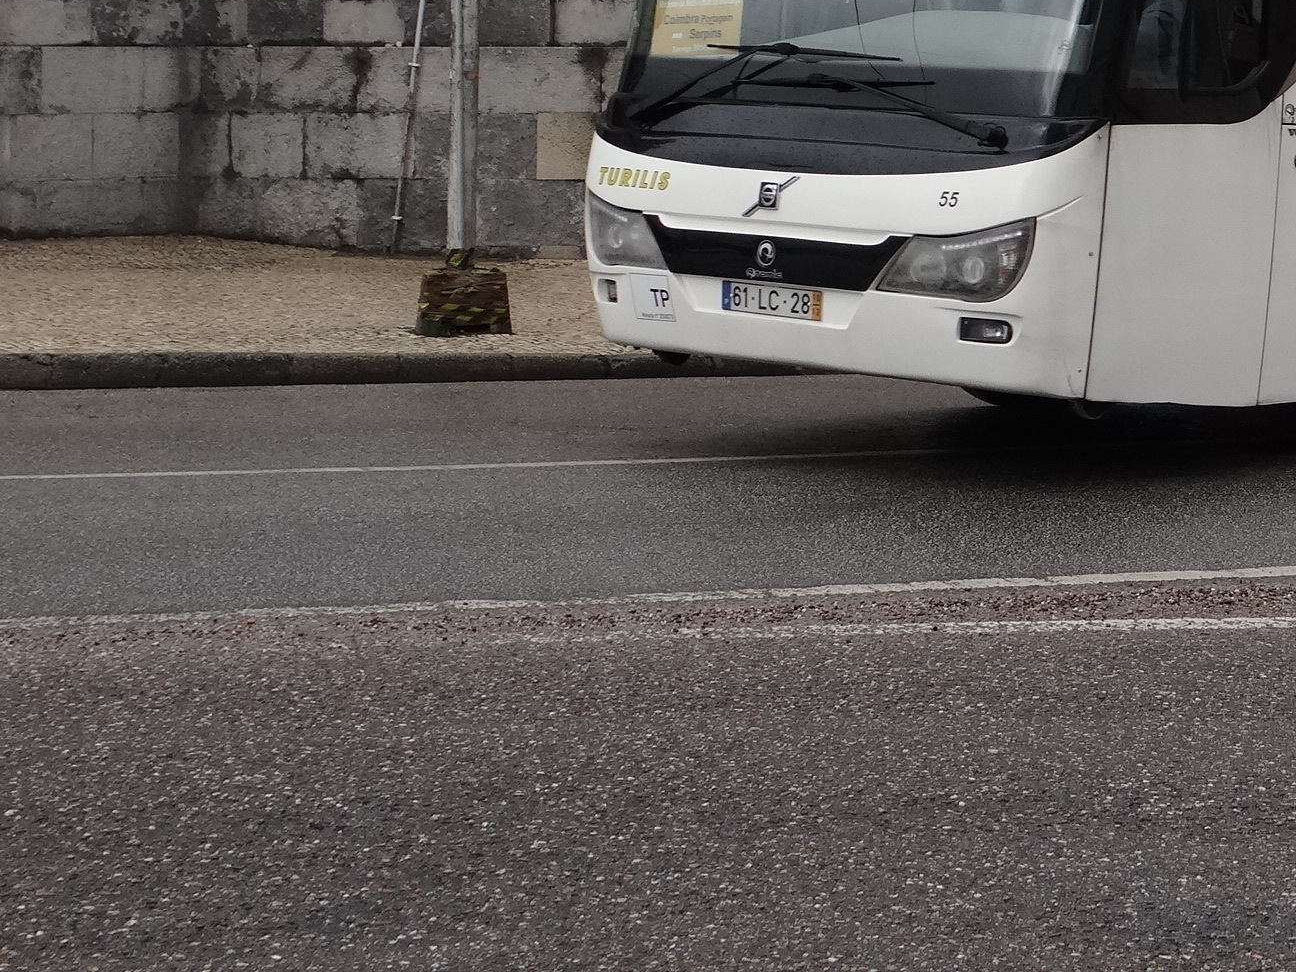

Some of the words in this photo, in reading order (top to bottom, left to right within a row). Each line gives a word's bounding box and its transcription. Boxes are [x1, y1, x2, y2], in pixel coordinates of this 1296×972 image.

[598, 166, 671, 191] TURILIS
[938, 191, 960, 208] 55
[650, 288, 670, 308] TP
